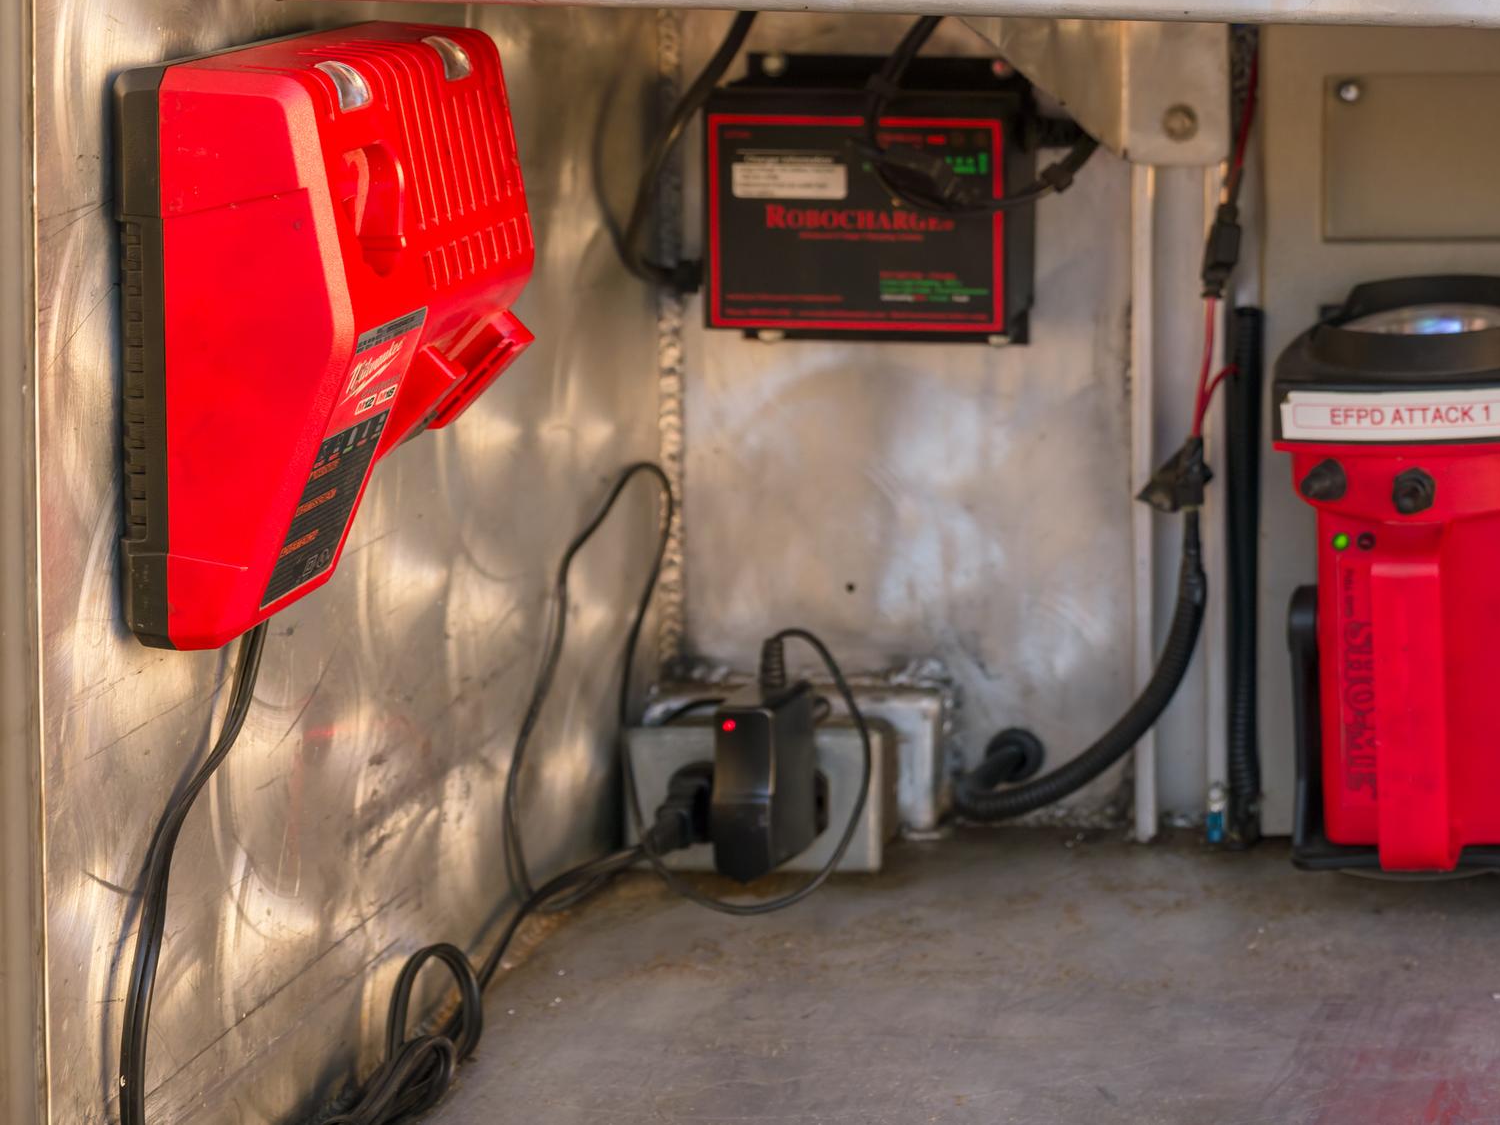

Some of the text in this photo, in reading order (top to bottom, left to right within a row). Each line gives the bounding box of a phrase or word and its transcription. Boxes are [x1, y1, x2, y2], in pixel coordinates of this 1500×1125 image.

[1330, 405, 1491, 425] EFPD ATTACK 1
